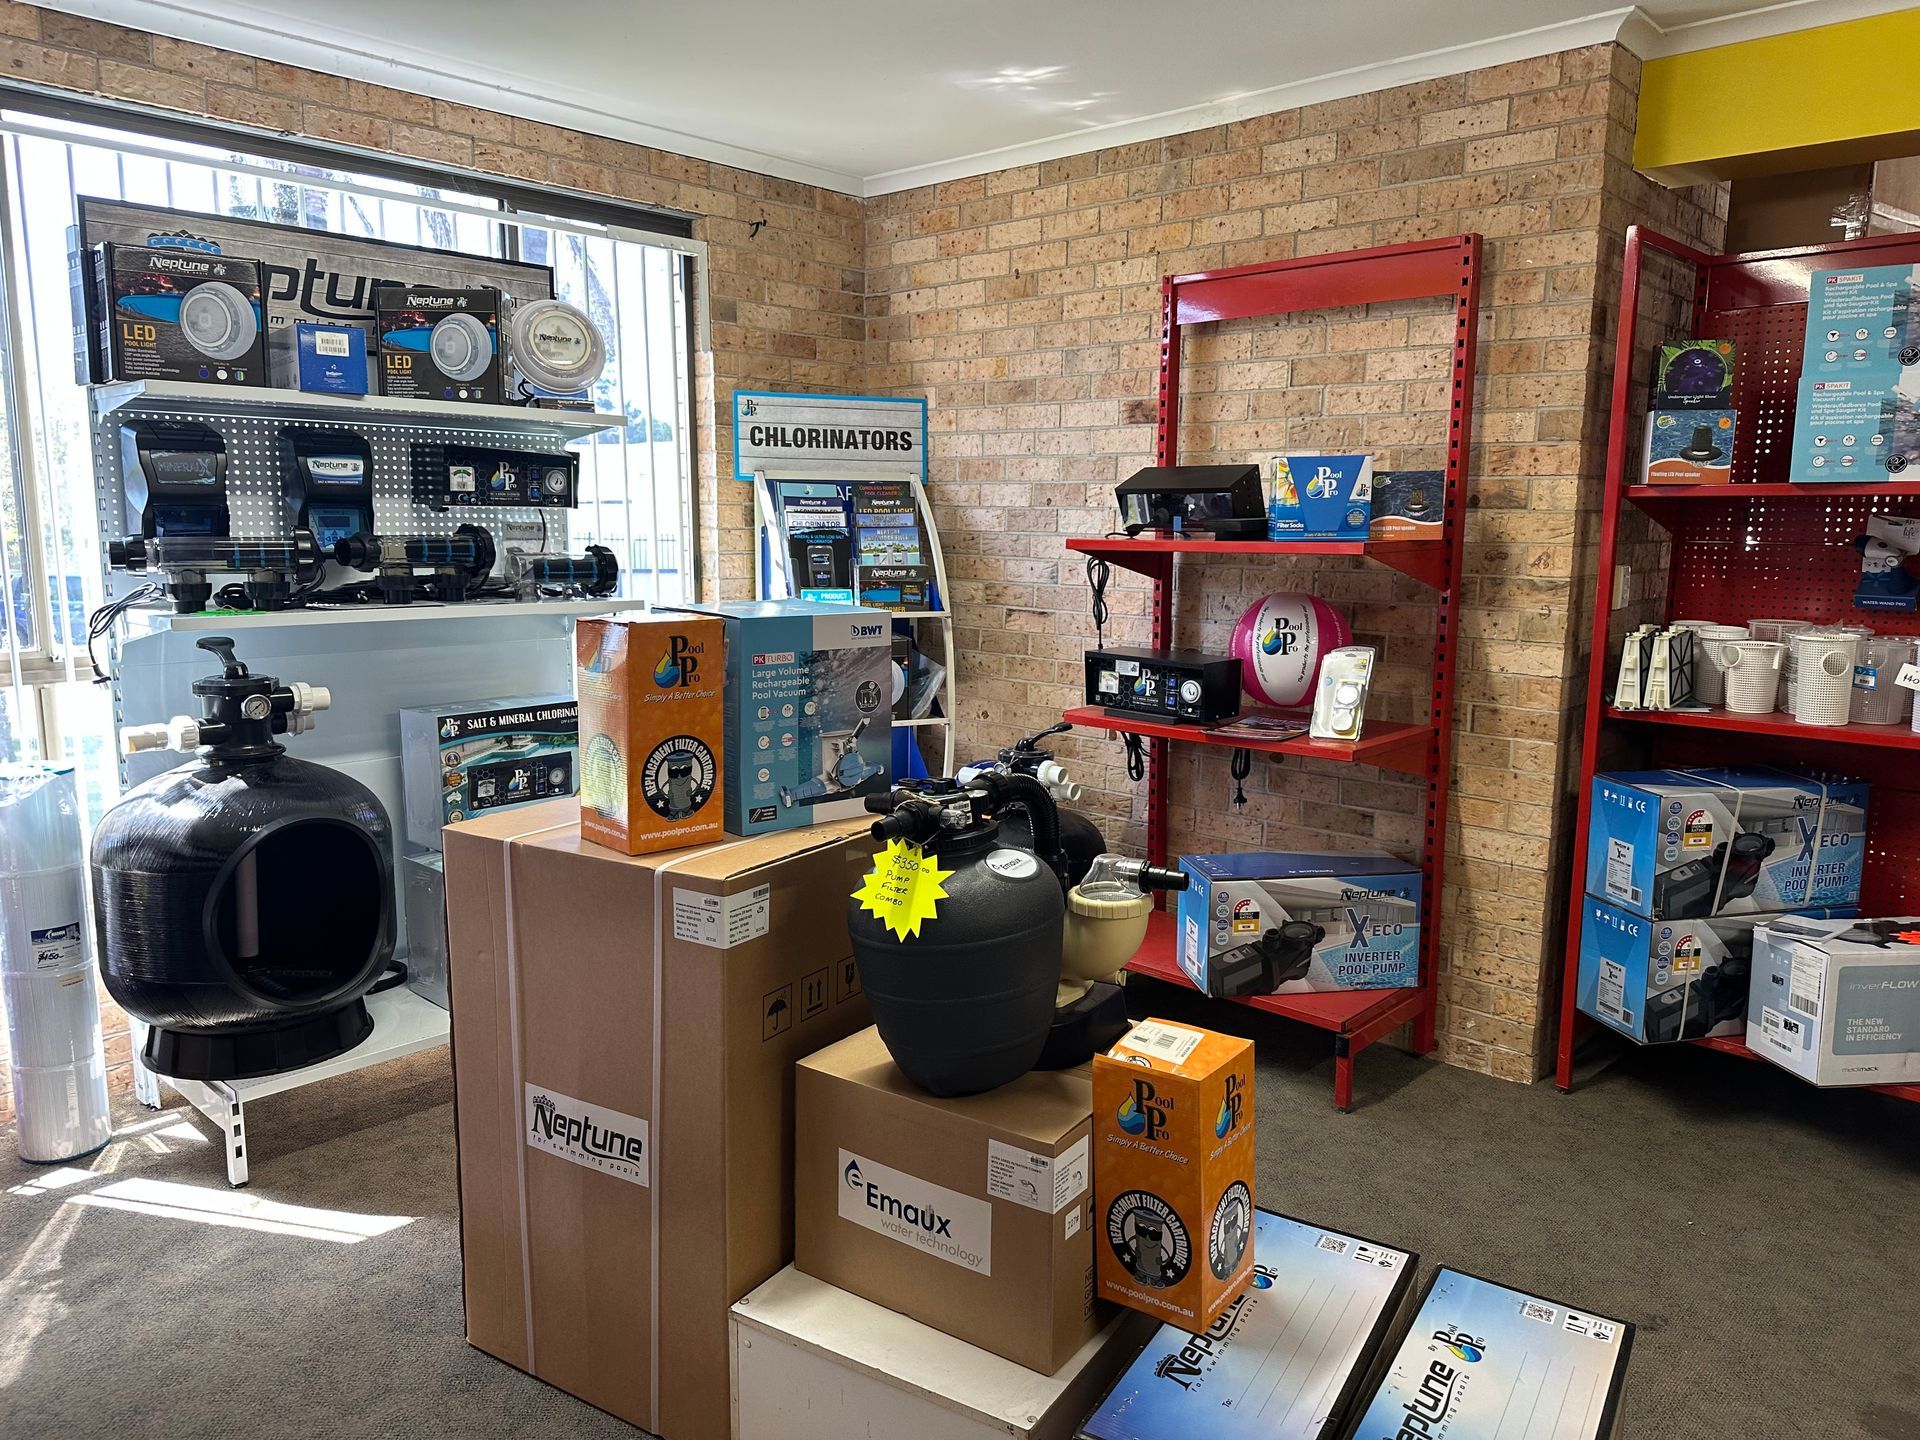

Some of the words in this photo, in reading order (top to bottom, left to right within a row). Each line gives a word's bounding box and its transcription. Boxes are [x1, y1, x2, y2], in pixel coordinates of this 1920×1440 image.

[149, 255, 209, 271] Neptune
[406, 295, 453, 306] Neptune
[123, 324, 156, 340] LED
[539, 334, 572, 343] Neptune
[387, 355, 412, 368] LED
[750, 426, 913, 451] CHLORINATORS
[312, 460, 348, 469] Neptune
[504, 473, 517, 490] Pro
[1317, 467, 1342, 485] Pool
[1322, 479, 1338, 498] Pro
[871, 568, 906, 577] Neptune
[861, 625, 883, 636] BWT
[1275, 617, 1302, 639] Pool
[669, 636, 704, 667] Pool
[1281, 632, 1298, 655] Pro
[753, 656, 764, 664] PK
[679, 656, 700, 687] Pro
[752, 669, 776, 679] Large
[778, 667, 809, 675] Volume
[1142, 668, 1159, 684] Pool
[752, 677, 809, 689] Rechargeable
[1145, 680, 1156, 696] Pro
[644, 694, 668, 703] Simply
[674, 691, 695, 699] Better
[696, 690, 715, 698] Choice
[752, 689, 770, 699] Pool
[773, 689, 806, 697] Vacuum
[467, 718, 487, 729] SALT
[489, 717, 496, 726] &
[499, 712, 535, 726] MINERAL
[537, 707, 578, 720] CHLORINAT
[645, 741, 674, 797] REPLACEMENT
[675, 739, 698, 753] FILTER
[695, 745, 714, 791] CARTRIDGE
[641, 822, 718, 840] www.poolpro.com.au
[1821, 833, 1850, 847] ECO
[1001, 858, 1022, 870] Emaux
[1792, 863, 1845, 878] INVRTER
[885, 870, 910, 883] PUMP
[1785, 879, 1807, 891] POO
[1817, 876, 1849, 888] PUMP
[875, 893, 903, 906] COMBO
[1341, 888, 1395, 900] Neptune
[1344, 951, 1400, 962] INVERTER
[1339, 965, 1368, 975] POOL
[1372, 963, 1406, 973] PUMP
[1849, 981, 1919, 990] inverFLOW
[1847, 1026, 1890, 1034] STANDARD
[1856, 1033, 1902, 1041] EFFICIENCY
[1133, 1078, 1174, 1114] Pool
[1225, 1074, 1246, 1113] Pool
[1231, 1093, 1243, 1131] Pro
[1145, 1104, 1170, 1141] Pro
[531, 1100, 642, 1169] Neptune
[533, 1134, 546, 1144] for
[553, 1143, 602, 1166] swimming
[610, 1163, 639, 1176] pools
[1107, 1134, 1132, 1148] Simply
[1140, 1143, 1163, 1156] Better
[1165, 1150, 1189, 1165] Choice
[866, 1181, 952, 1239] Emaux
[1109, 1193, 1141, 1244] REPLACEMENT
[1142, 1195, 1170, 1218] FILTER
[1165, 1214, 1189, 1270] CARTRIDGE
[880, 1217, 912, 1238] water
[916, 1231, 984, 1267] technology
[1106, 1280, 1194, 1318] www.poolpro.com.au
[1432, 1324, 1463, 1349] Pool
[1455, 1333, 1486, 1352] Pro
[1192, 1377, 1204, 1392] for
[1206, 1327, 1240, 1372] swimming
[1240, 1300, 1258, 1323] pools
[1222, 1399, 1233, 1408] To:
[1395, 1360, 1462, 1440] eptune
[1438, 1408, 1457, 1440] mming
[1455, 1375, 1470, 1403] pools
